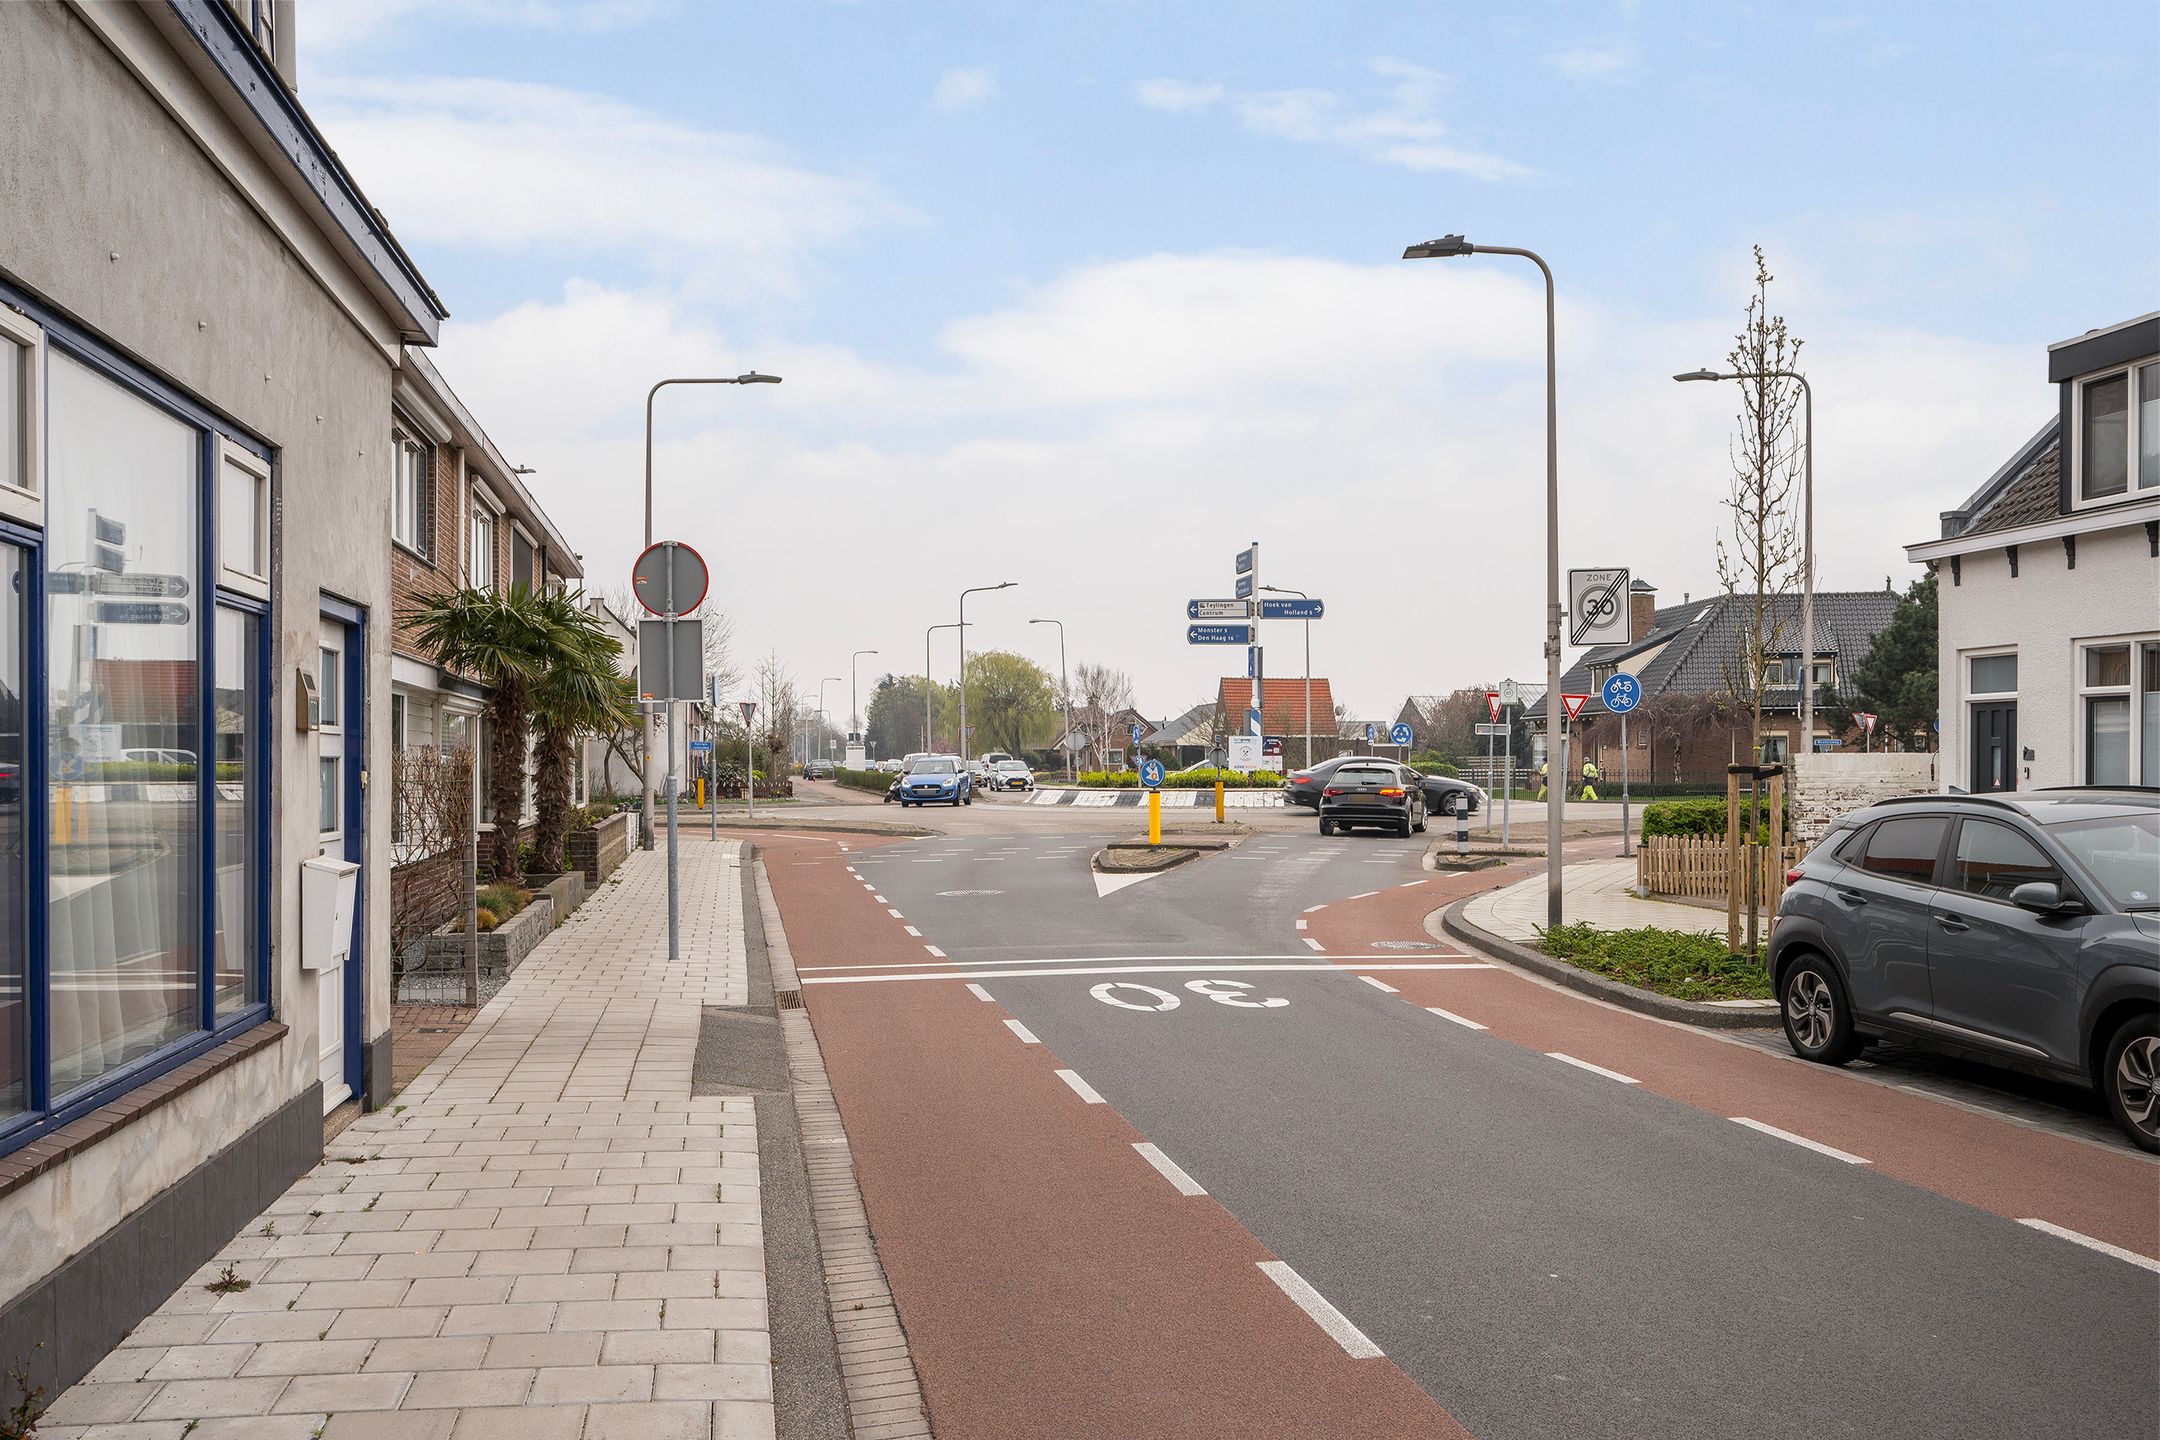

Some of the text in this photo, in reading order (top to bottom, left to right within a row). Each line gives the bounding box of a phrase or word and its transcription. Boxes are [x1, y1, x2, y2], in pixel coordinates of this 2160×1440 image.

[1587, 574, 1612, 582] ZONE
[1586, 598, 1614, 616] 30
[1090, 979, 1290, 1011] 30
